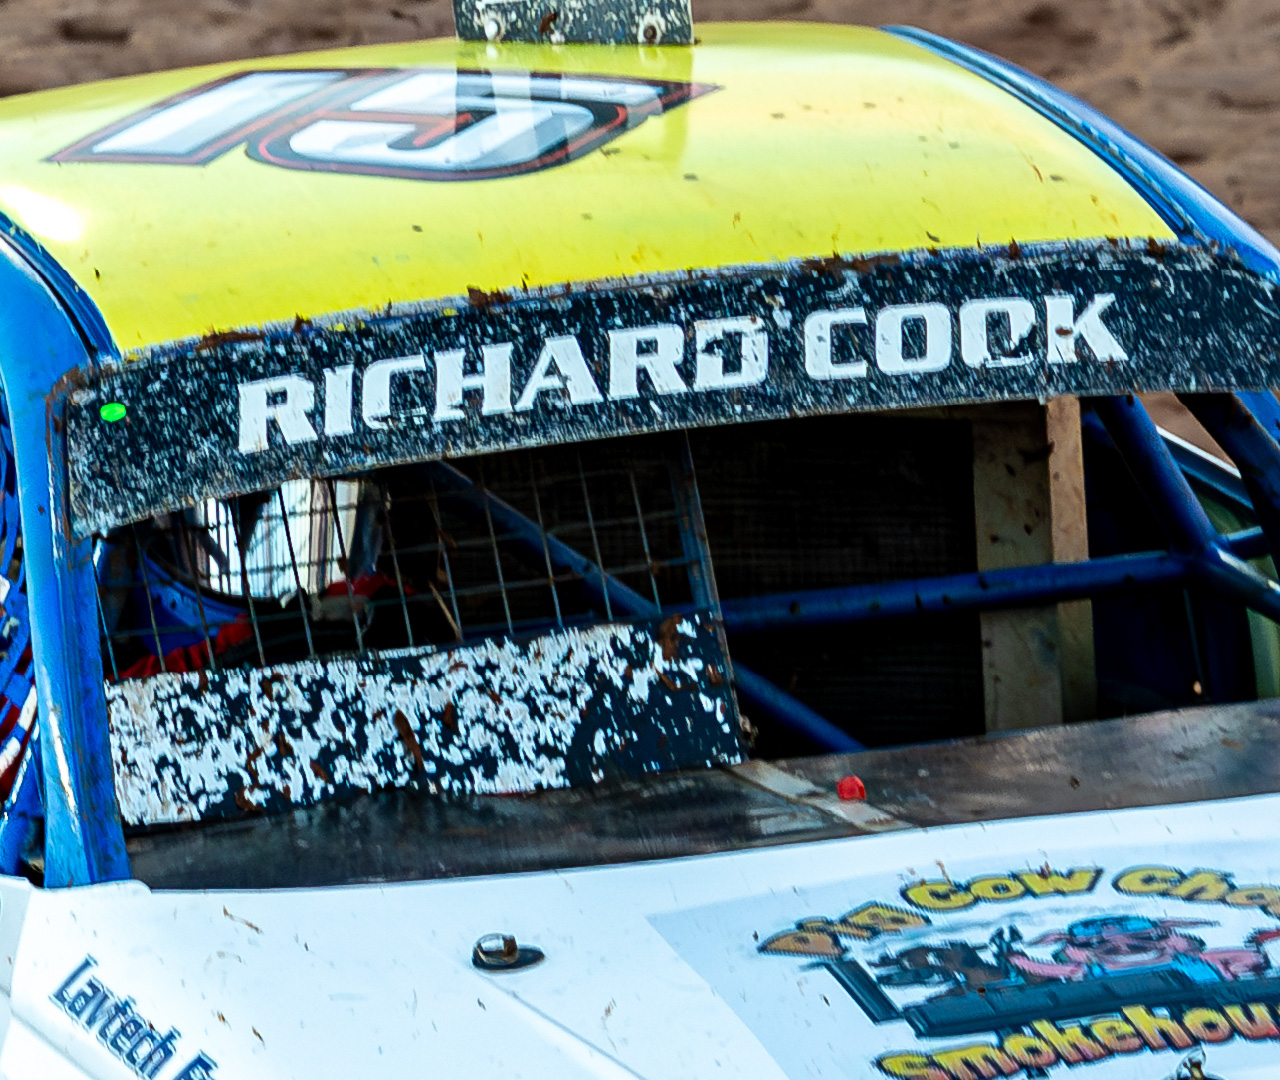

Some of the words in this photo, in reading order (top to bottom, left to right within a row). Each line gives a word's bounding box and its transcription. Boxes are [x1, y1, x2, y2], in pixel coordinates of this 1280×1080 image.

[62, 68, 700, 180] 15
[237, 312, 770, 456] RICHARD
[803, 291, 1130, 383] COOK
